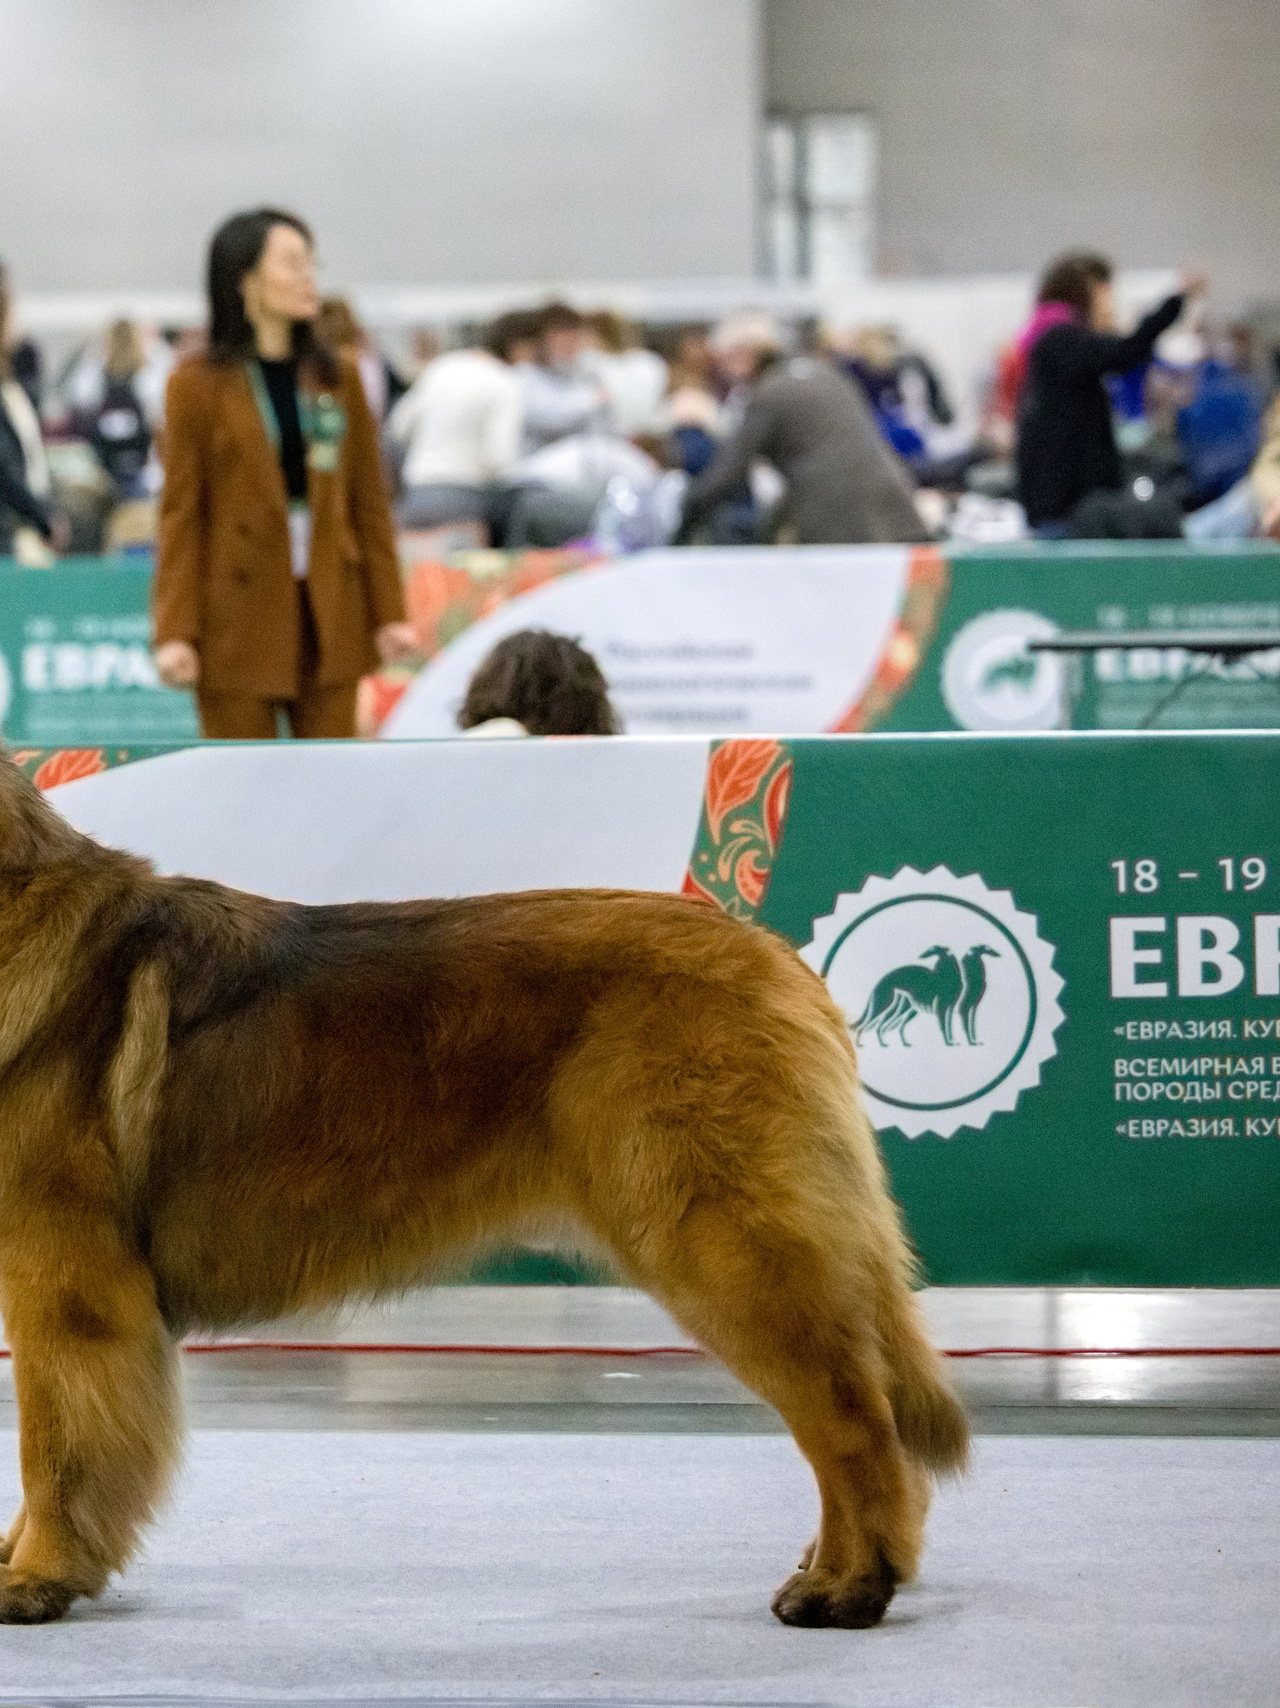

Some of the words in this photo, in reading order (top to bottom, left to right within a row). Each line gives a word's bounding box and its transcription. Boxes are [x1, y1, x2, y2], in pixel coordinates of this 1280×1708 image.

[1111, 859, 1158, 894] 18
[1218, 857, 1266, 892] 19
[1114, 1056, 1266, 1077] ВСЕМИРНАЯ
[1114, 1081, 1222, 1103] ПОРОДЫ
[1245, 1117, 1280, 1137] КУ
